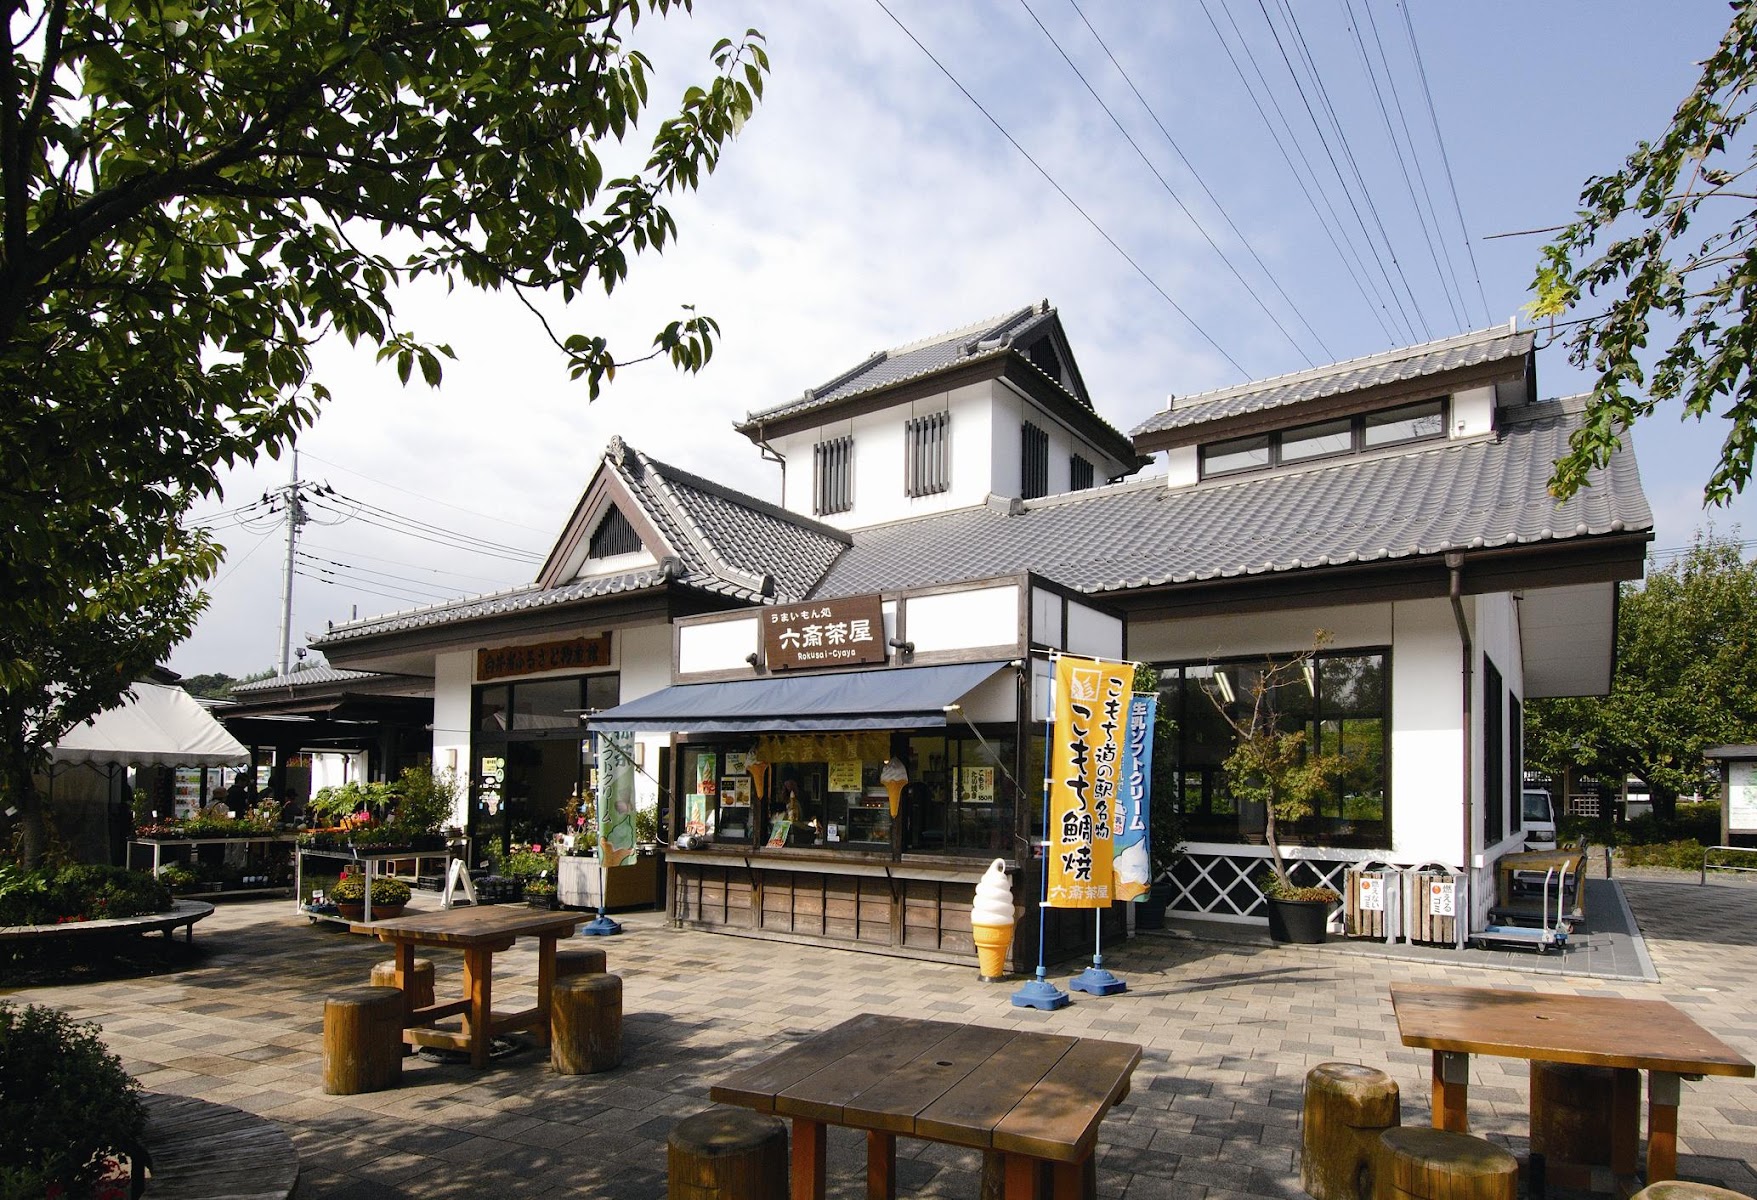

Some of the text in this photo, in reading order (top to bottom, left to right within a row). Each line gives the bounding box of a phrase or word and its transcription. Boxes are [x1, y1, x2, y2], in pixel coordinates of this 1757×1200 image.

[771, 607, 832, 623] うまいもん処
[778, 619, 874, 650] 六斎茶屋
[797, 649, 856, 660] Rokusai-Cyaya
[1094, 677, 1123, 840] こもち道の駅名物
[1129, 701, 1148, 831] 生乳ソフトクリーム
[1062, 703, 1093, 880] こもち鯛焼
[1050, 885, 1109, 900] 六斎茶屋
[1433, 896, 1442, 913] ゴミ
[1442, 884, 1453, 912] 燃える
